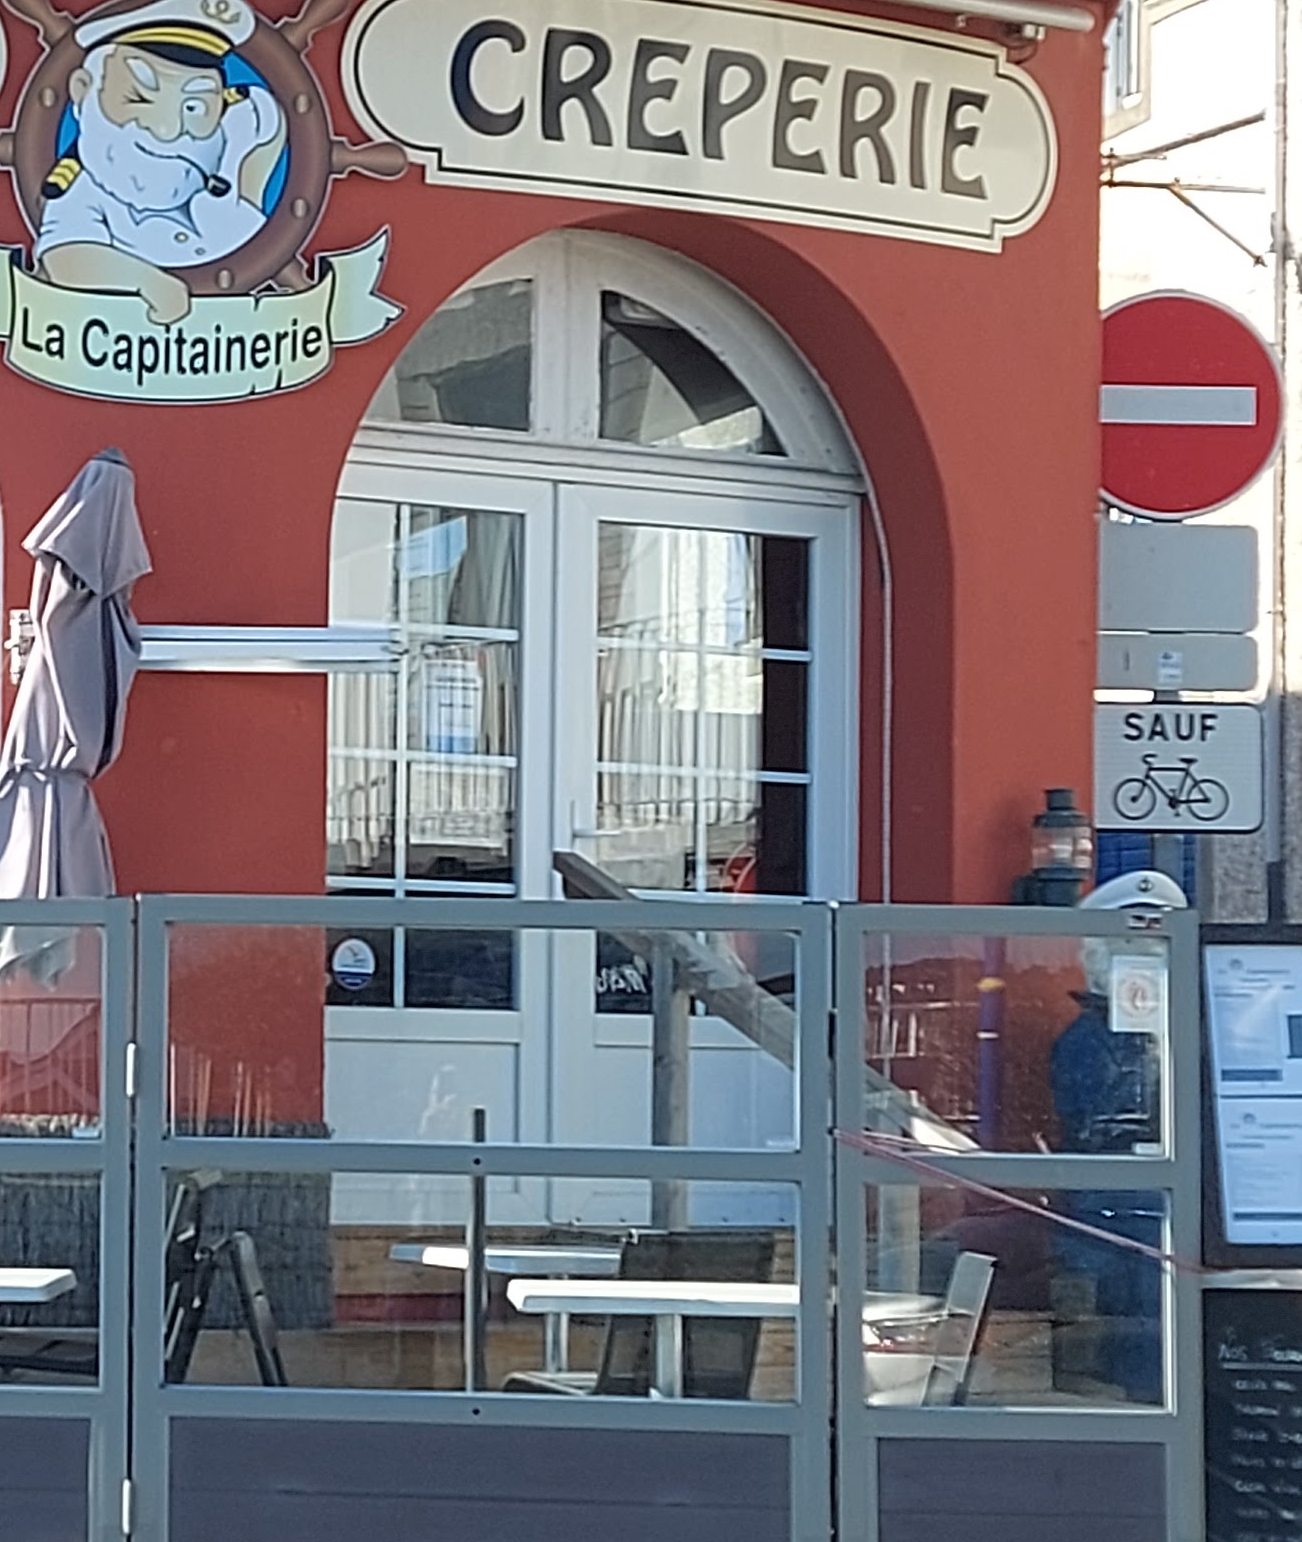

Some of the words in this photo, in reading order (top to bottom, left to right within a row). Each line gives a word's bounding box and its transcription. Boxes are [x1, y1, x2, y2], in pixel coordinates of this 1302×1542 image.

[448, 18, 991, 201] CREPERIE
[21, 306, 65, 360] La
[81, 316, 323, 387] Capitainerie
[1122, 712, 1219, 743] SAUF
